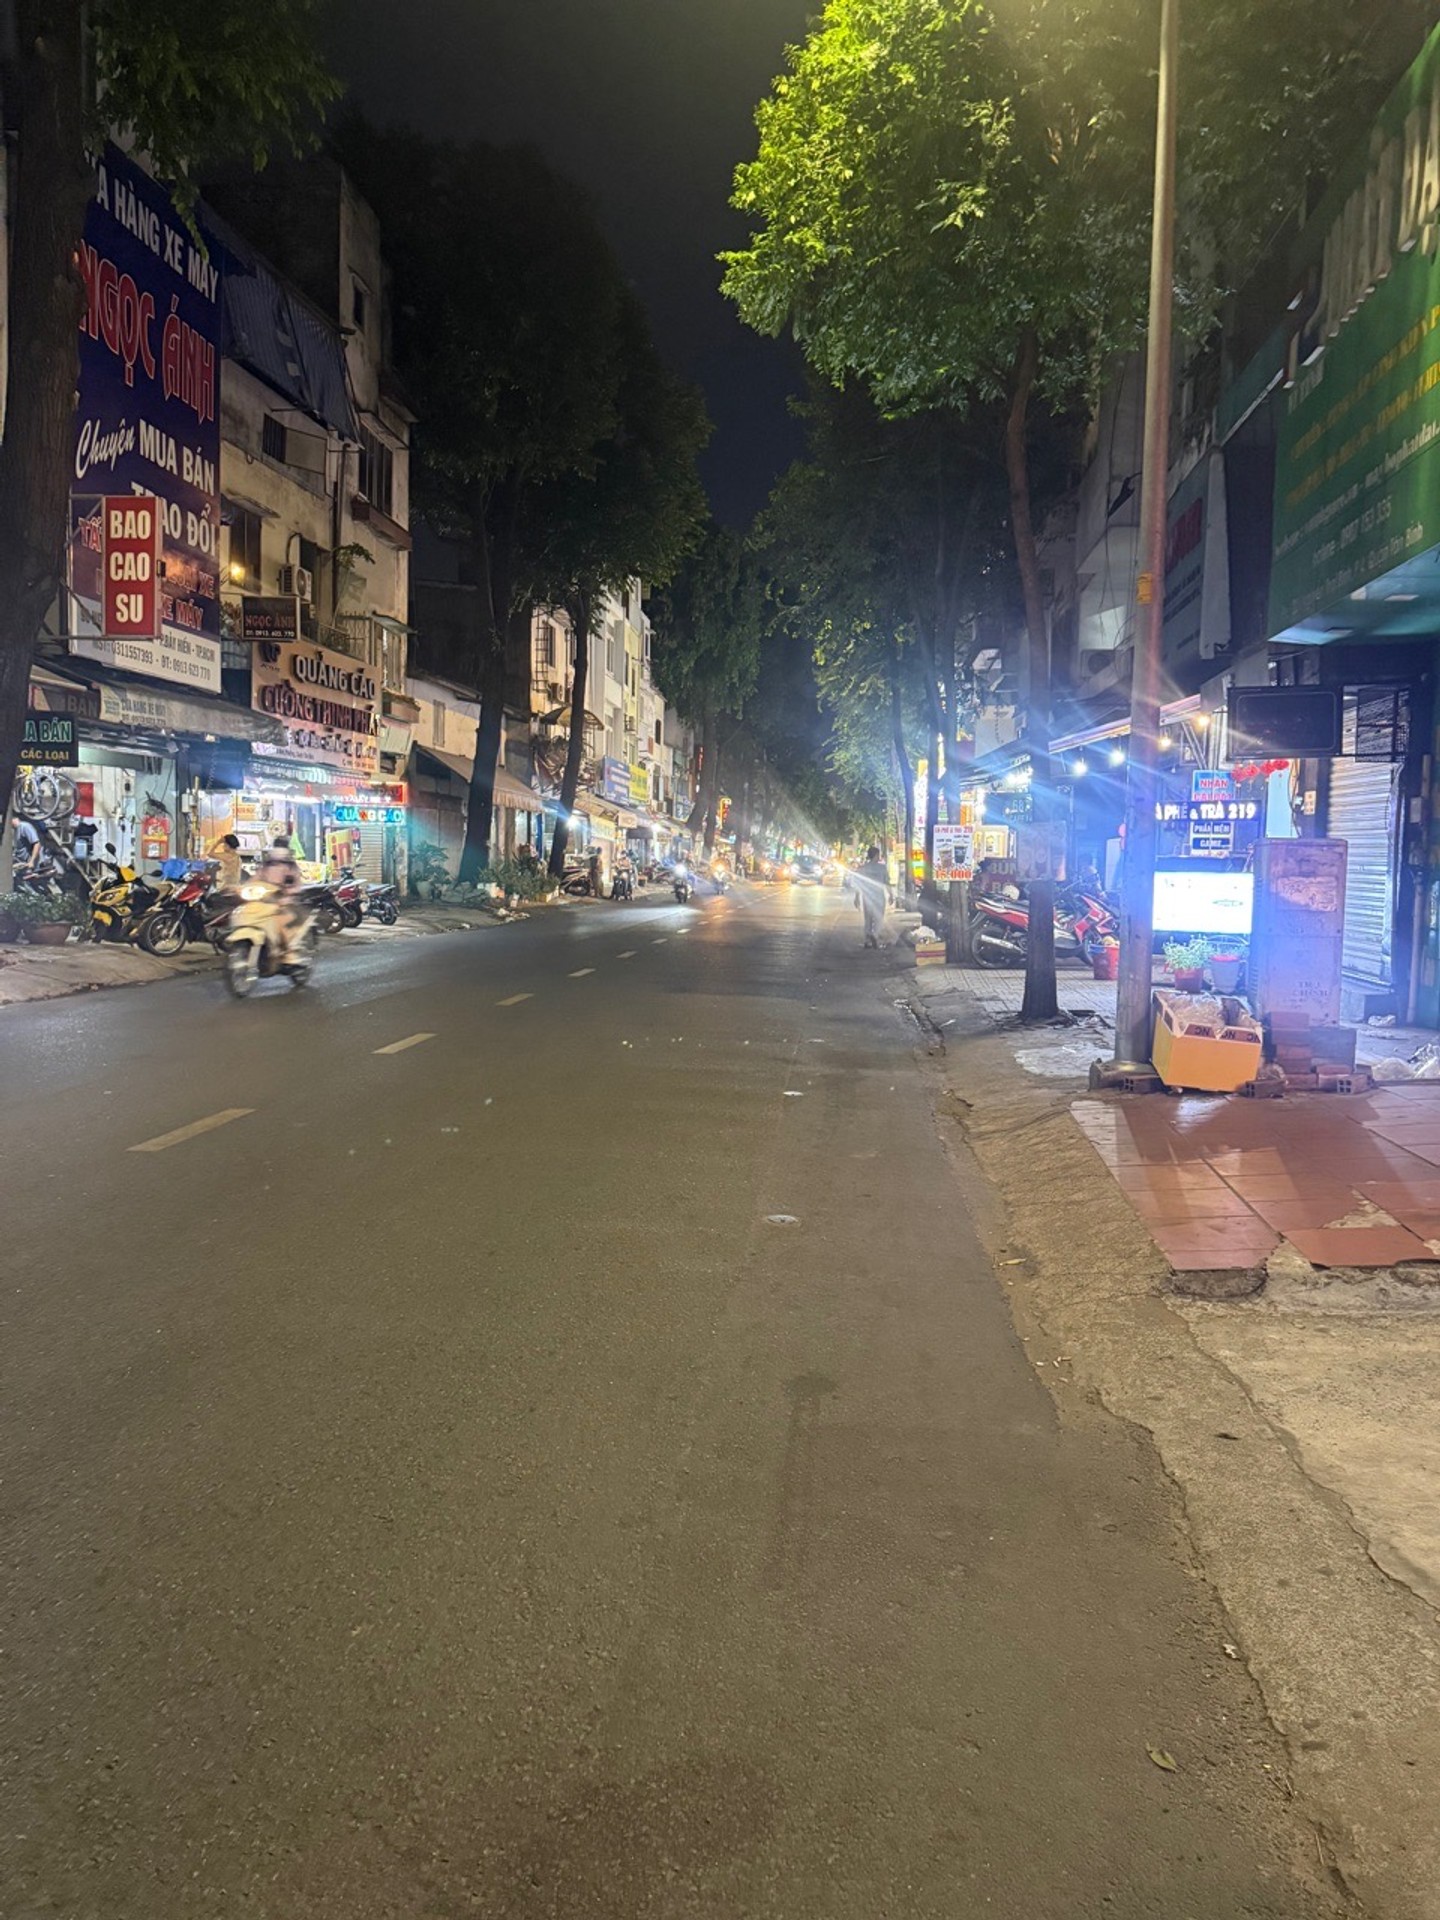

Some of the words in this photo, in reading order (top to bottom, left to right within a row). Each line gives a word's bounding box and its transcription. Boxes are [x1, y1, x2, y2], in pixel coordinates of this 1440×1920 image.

[114, 178, 160, 256] HÀNG
[164, 223, 184, 276] XE
[79, 238, 155, 388] NGỌC
[162, 293, 215, 425] ÁNH
[75, 418, 136, 479] Chuyên
[139, 418, 178, 476] MUA
[182, 446, 215, 497] BÁN
[110, 510, 151, 540] BAO
[187, 503, 216, 557] ĐỔI
[110, 551, 150, 582] CAO
[199, 571, 215, 600] XE
[115, 593, 144, 623] SU
[294, 651, 348, 691] QUẢNG
[349, 667, 376, 699] CÁO
[20, 747, 42, 759] CÁC
[45, 750, 69, 763] LOẠI
[1164, 802, 1188, 820] PHÊ
[1189, 808, 1199, 820] &
[1200, 800, 1225, 820] TRÀ
[1228, 802, 1256, 820] 219
